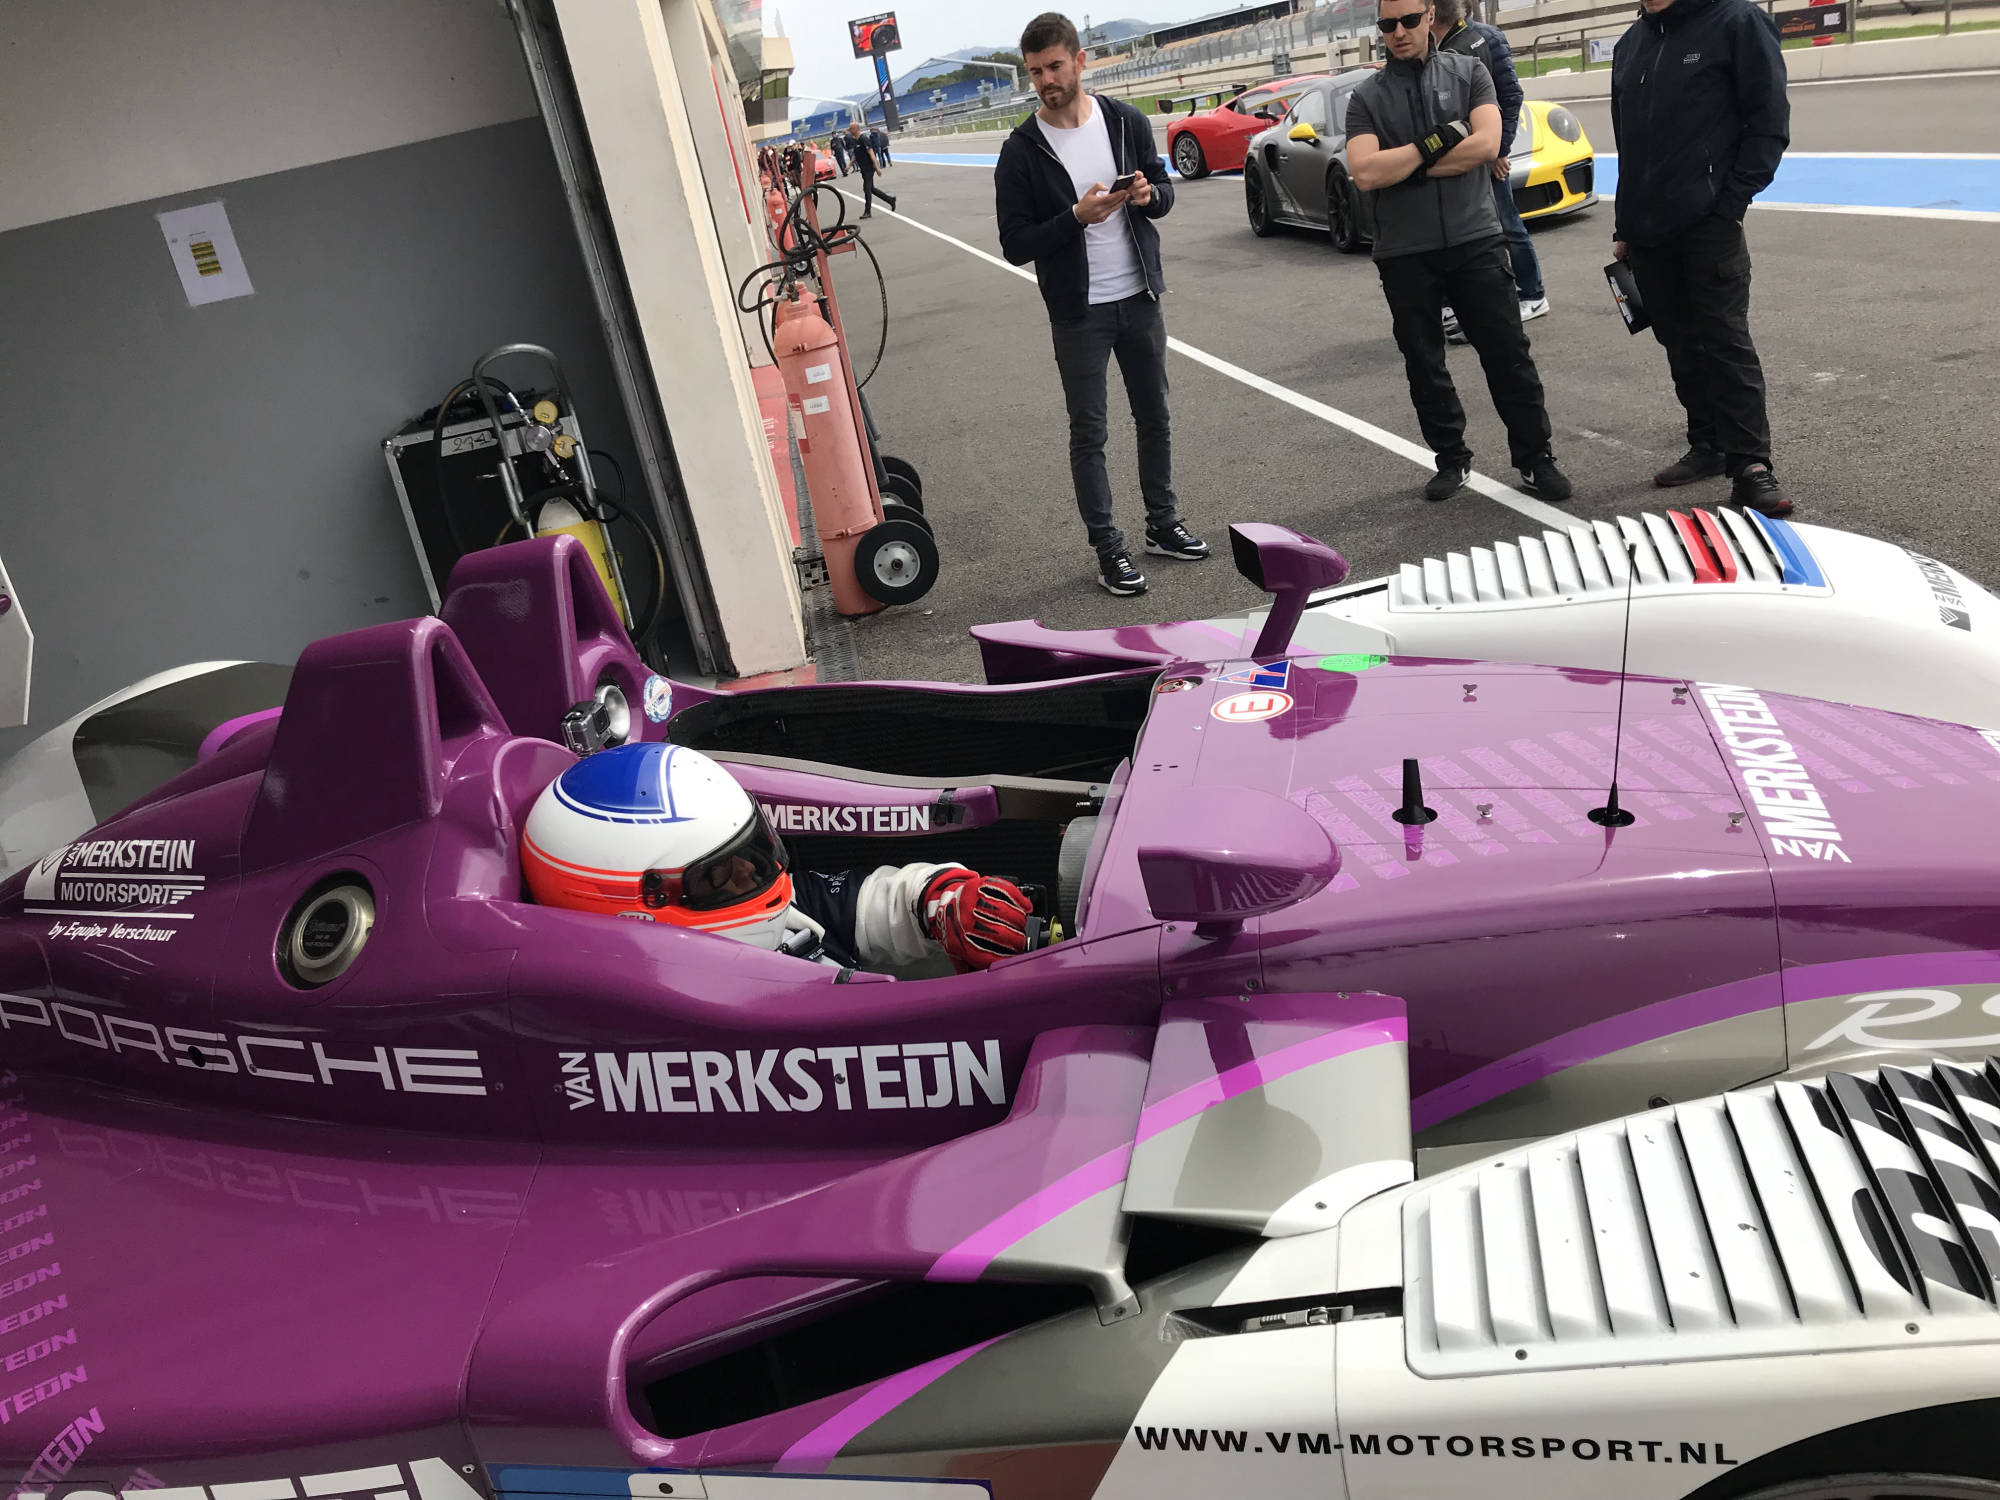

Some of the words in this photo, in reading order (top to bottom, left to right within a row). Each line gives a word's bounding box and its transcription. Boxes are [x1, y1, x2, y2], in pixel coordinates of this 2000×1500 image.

[63, 842, 84, 867] VAN
[1771, 837, 1852, 863] VAN
[61, 882, 174, 905] MOTORSPORT
[48, 921, 67, 940] by
[64, 922, 107, 941] Equipe
[108, 923, 177, 942] Verschuur
[0, 994, 487, 1096] PORSCHE
[559, 1052, 595, 1111] VAN
[1134, 1426, 1738, 1465] WWW.VM-MOTORSPORT.NL
